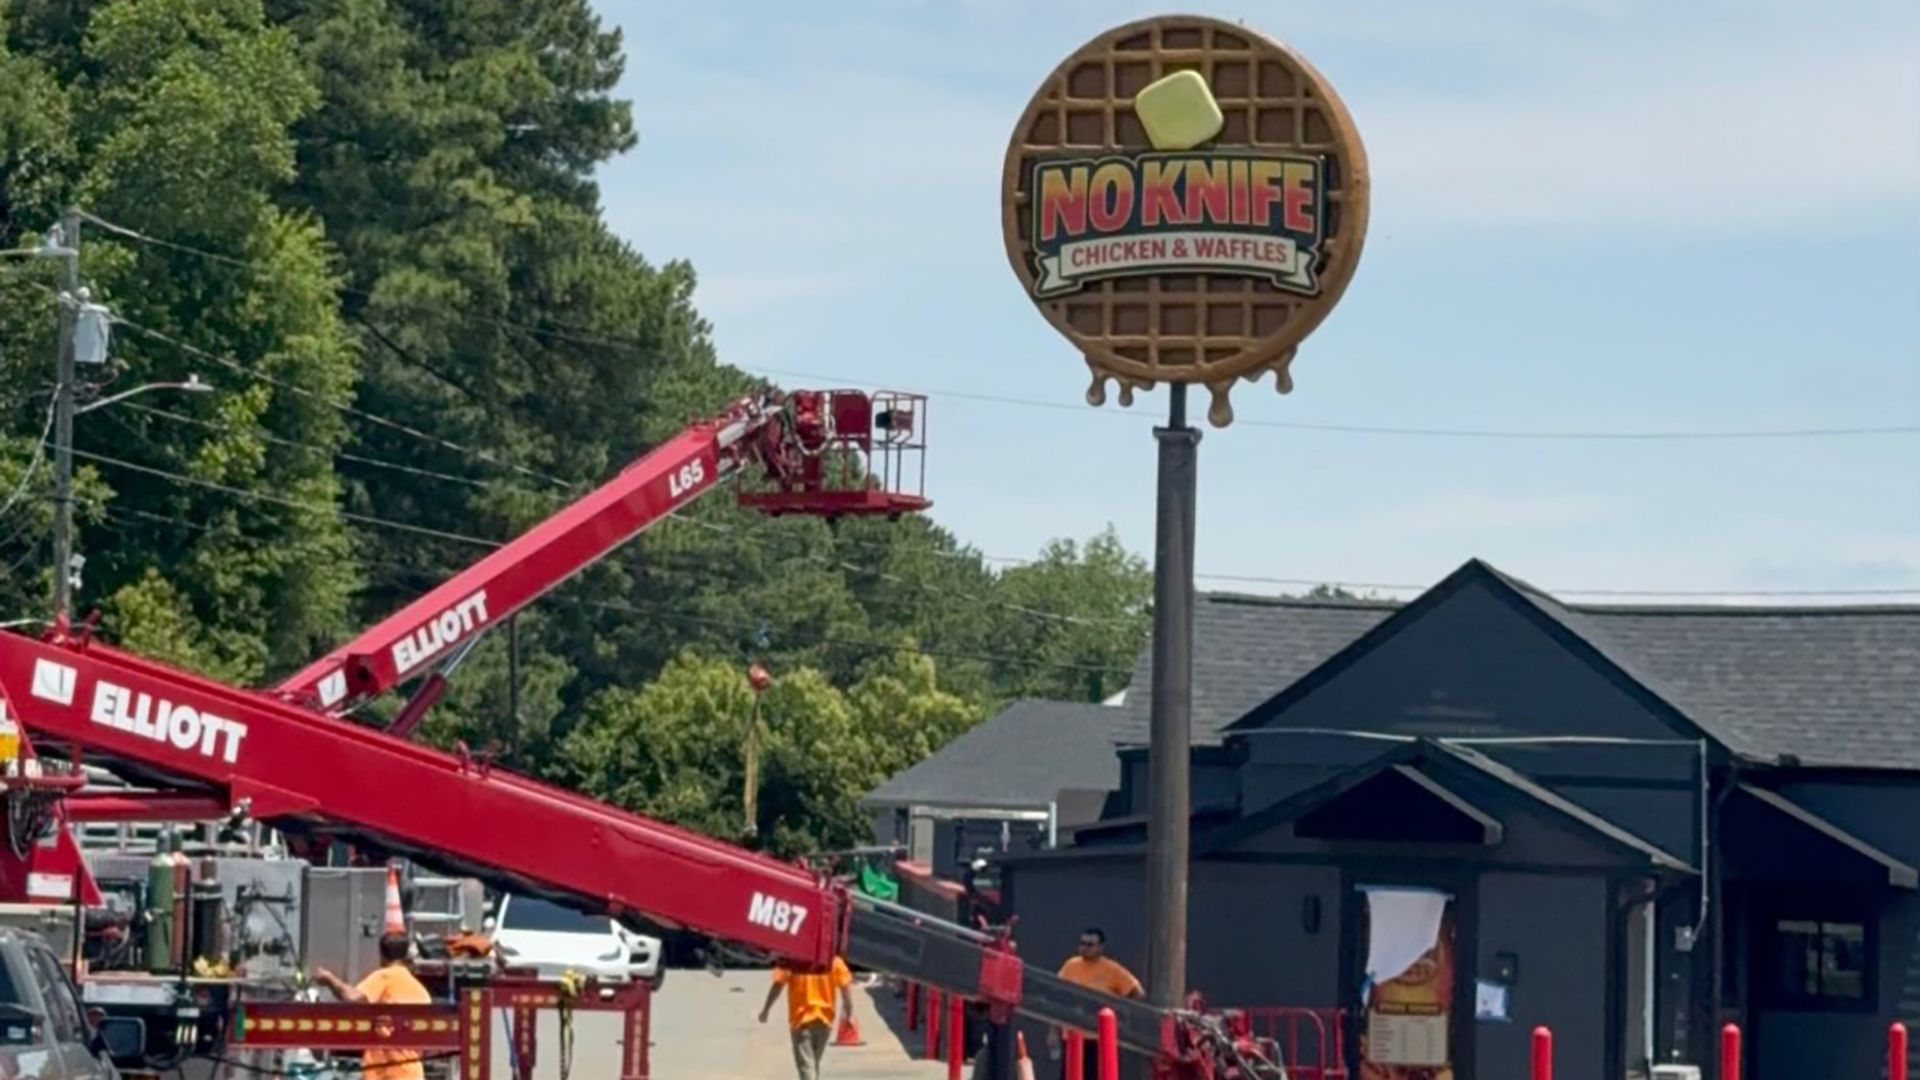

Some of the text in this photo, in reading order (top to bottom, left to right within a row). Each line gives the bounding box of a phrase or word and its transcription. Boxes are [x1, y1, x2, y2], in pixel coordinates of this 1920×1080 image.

[1040, 159, 1316, 241] NO KNIFE
[1071, 237, 1288, 267] CHICKEN & WAFFLES
[668, 458, 704, 498] L65
[391, 589, 488, 675] ELLIOTT
[90, 680, 248, 764] ELLIOTT
[747, 891, 808, 936] M87
